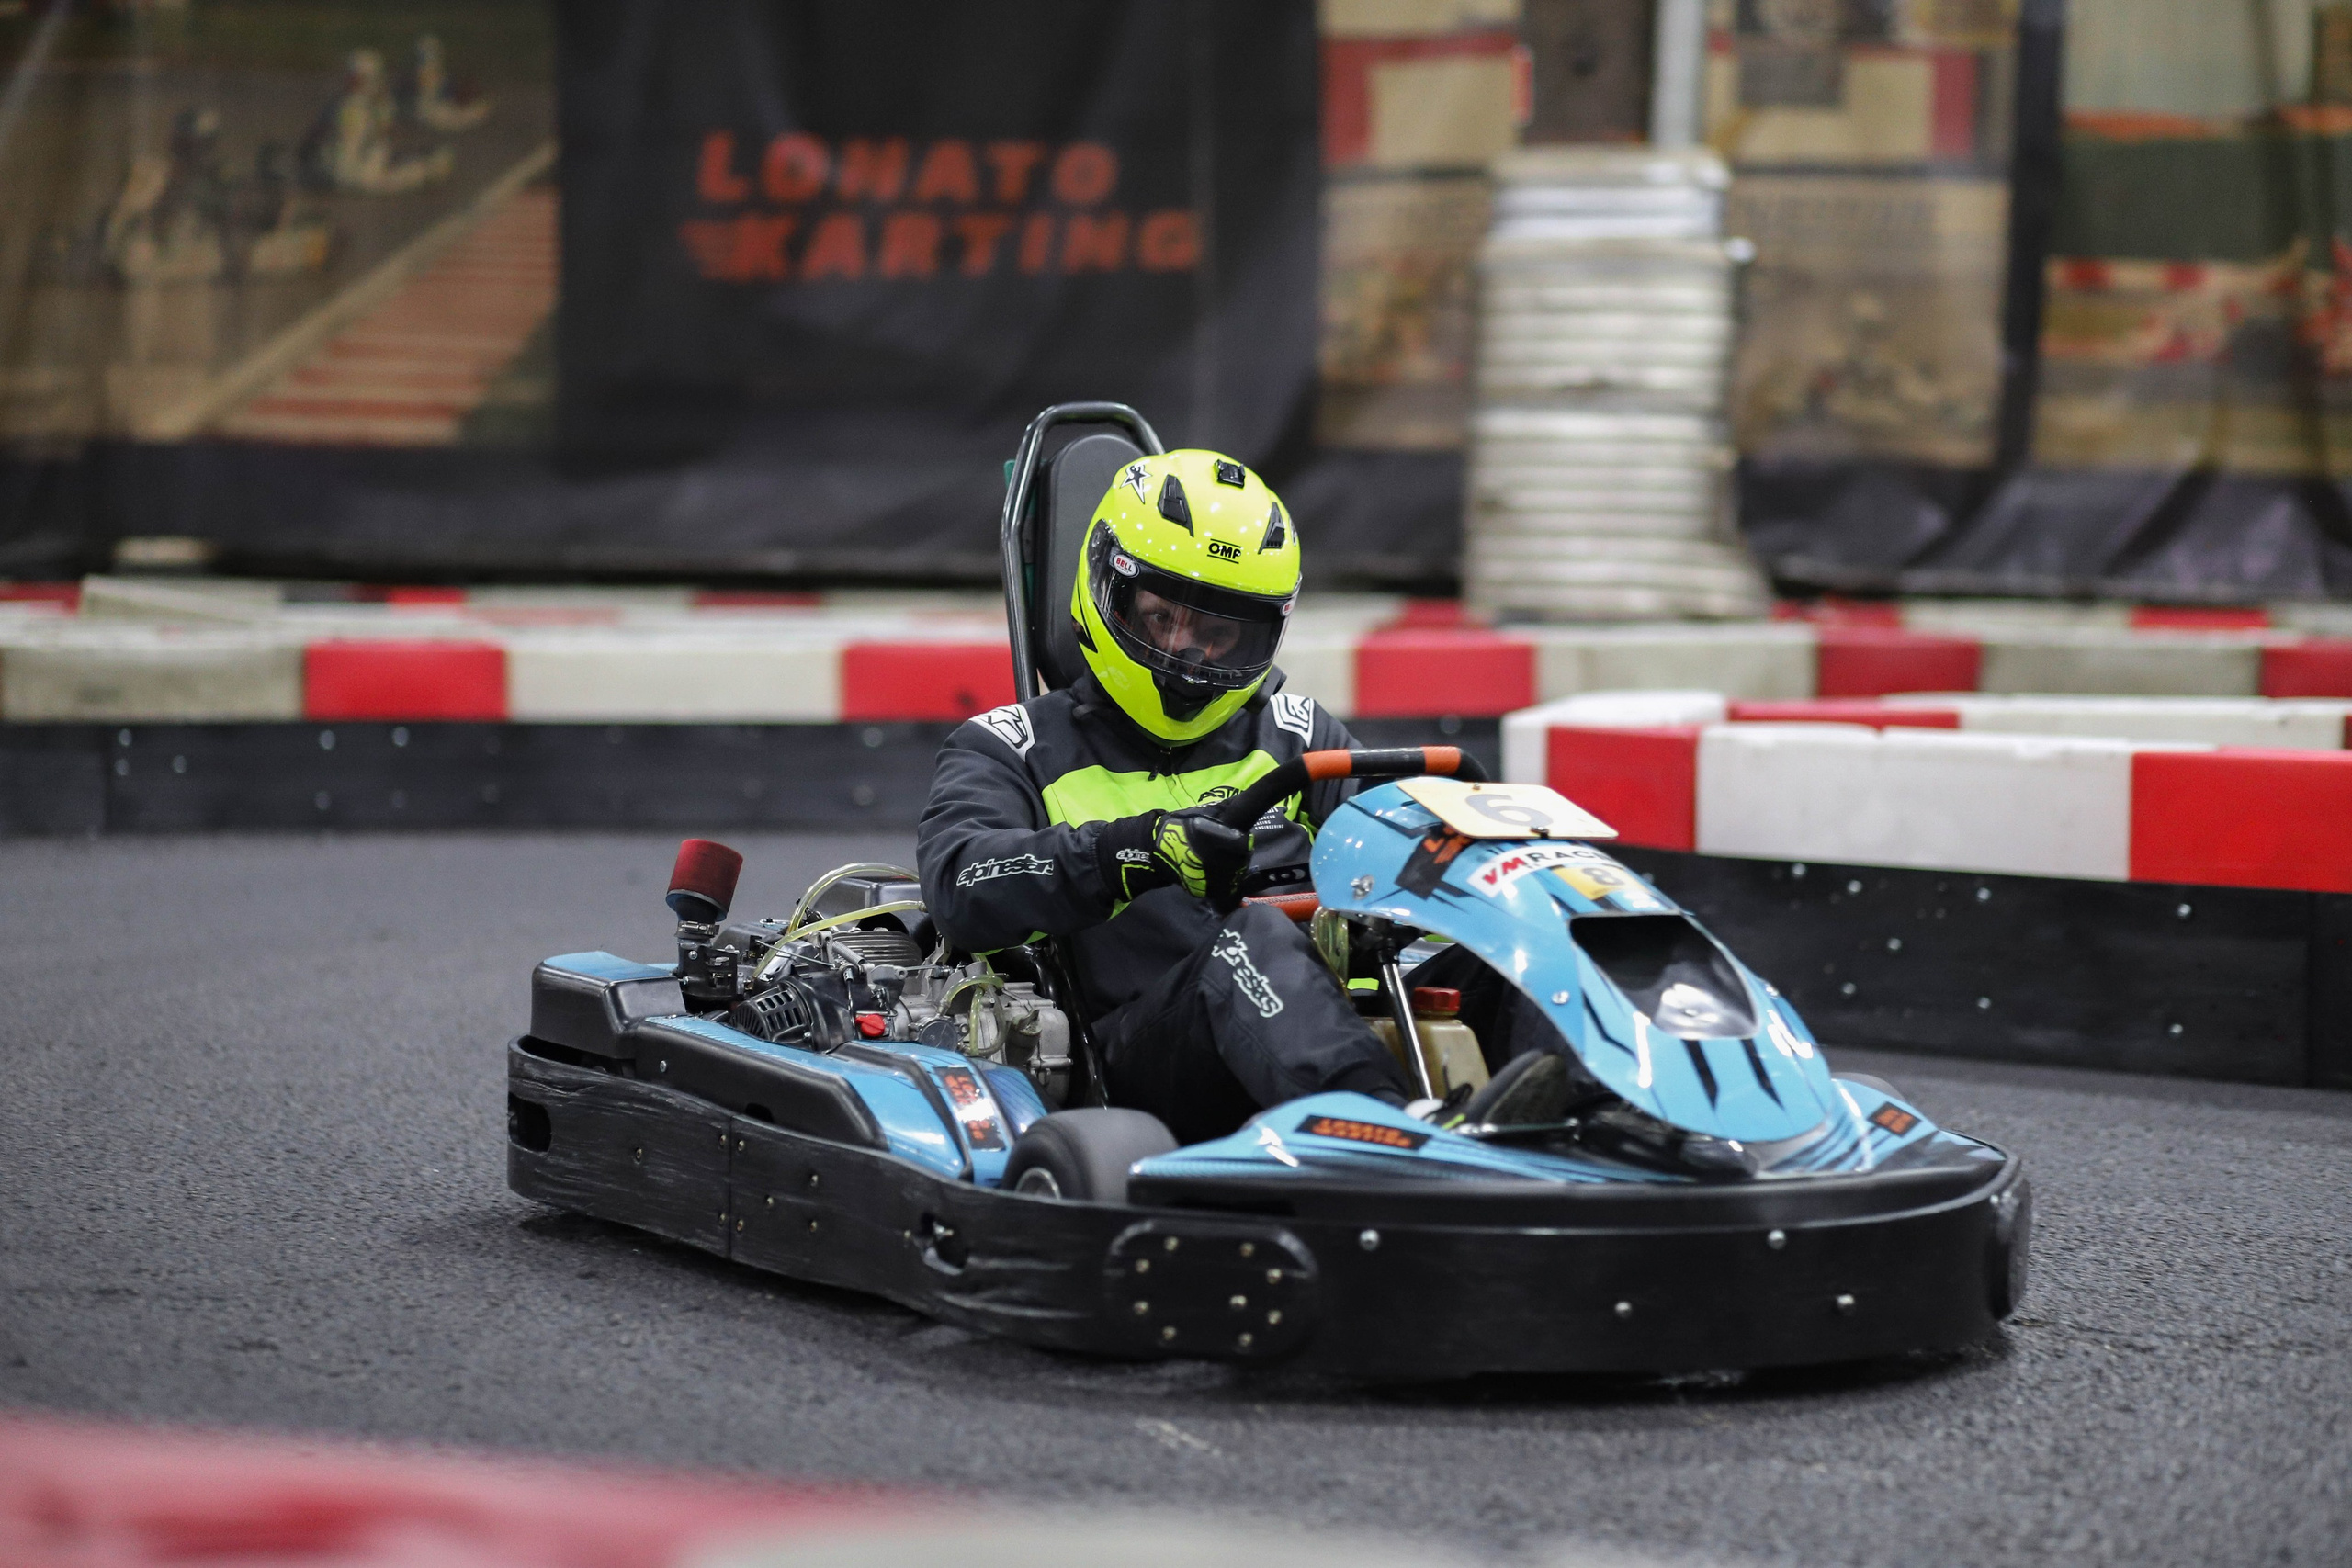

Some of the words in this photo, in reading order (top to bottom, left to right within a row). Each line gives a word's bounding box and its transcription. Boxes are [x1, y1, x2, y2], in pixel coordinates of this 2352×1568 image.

[685, 209, 1203, 280] KARTING
[1208, 542, 1242, 560] OMP
[1116, 557, 1132, 572] BELL
[1464, 793, 1555, 828] 6
